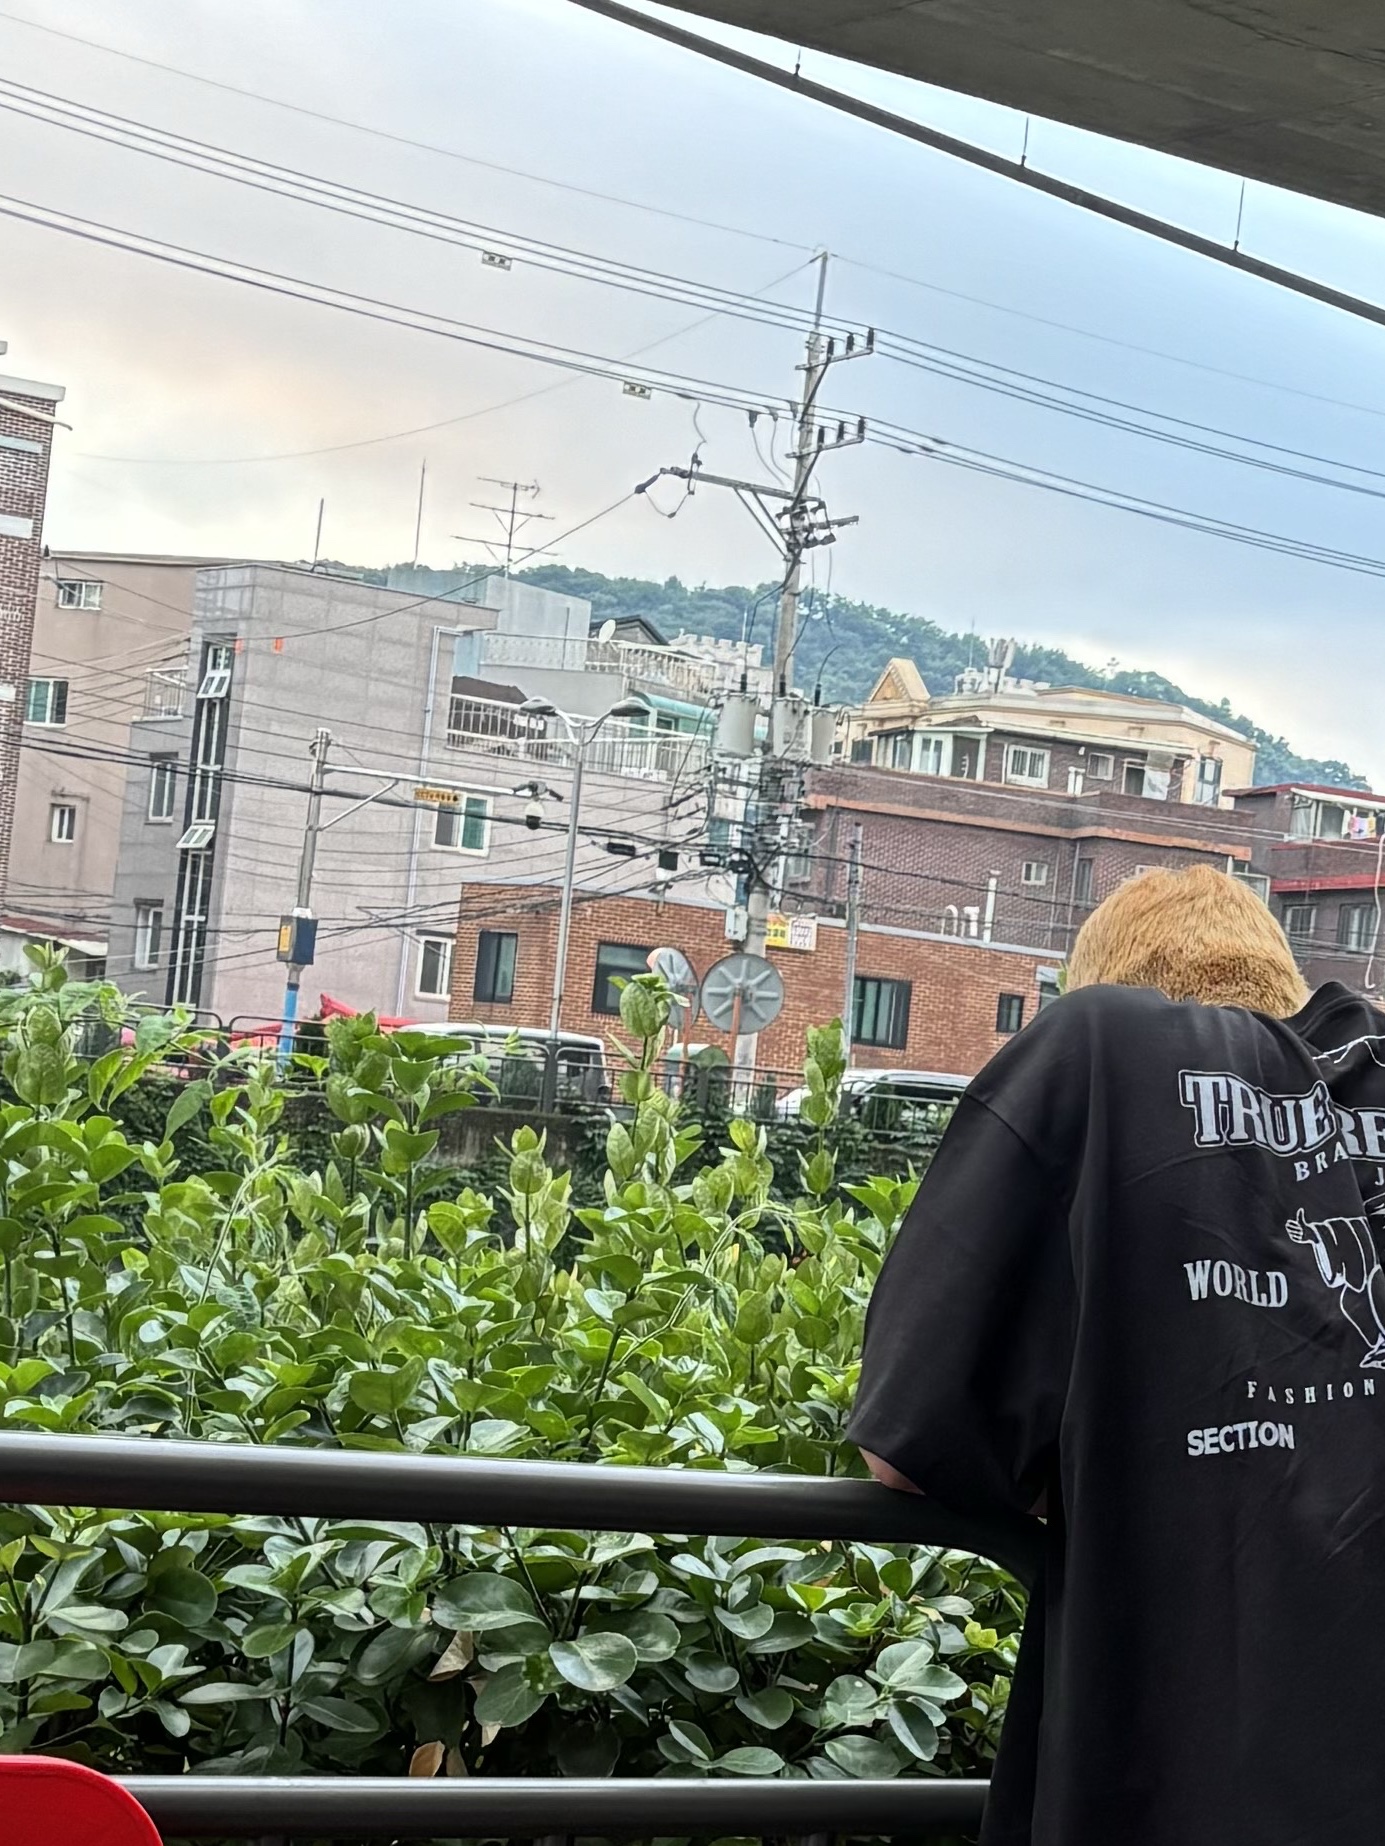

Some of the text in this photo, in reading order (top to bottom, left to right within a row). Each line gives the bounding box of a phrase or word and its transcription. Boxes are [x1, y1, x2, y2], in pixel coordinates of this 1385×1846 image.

[1180, 1070, 1336, 1156] TRUE
[1294, 1141, 1349, 1181] BRA
[1183, 1259, 1289, 1308] WORLD
[1247, 1379, 1376, 1404] FASHION
[1187, 1420, 1296, 1456] SECTION
